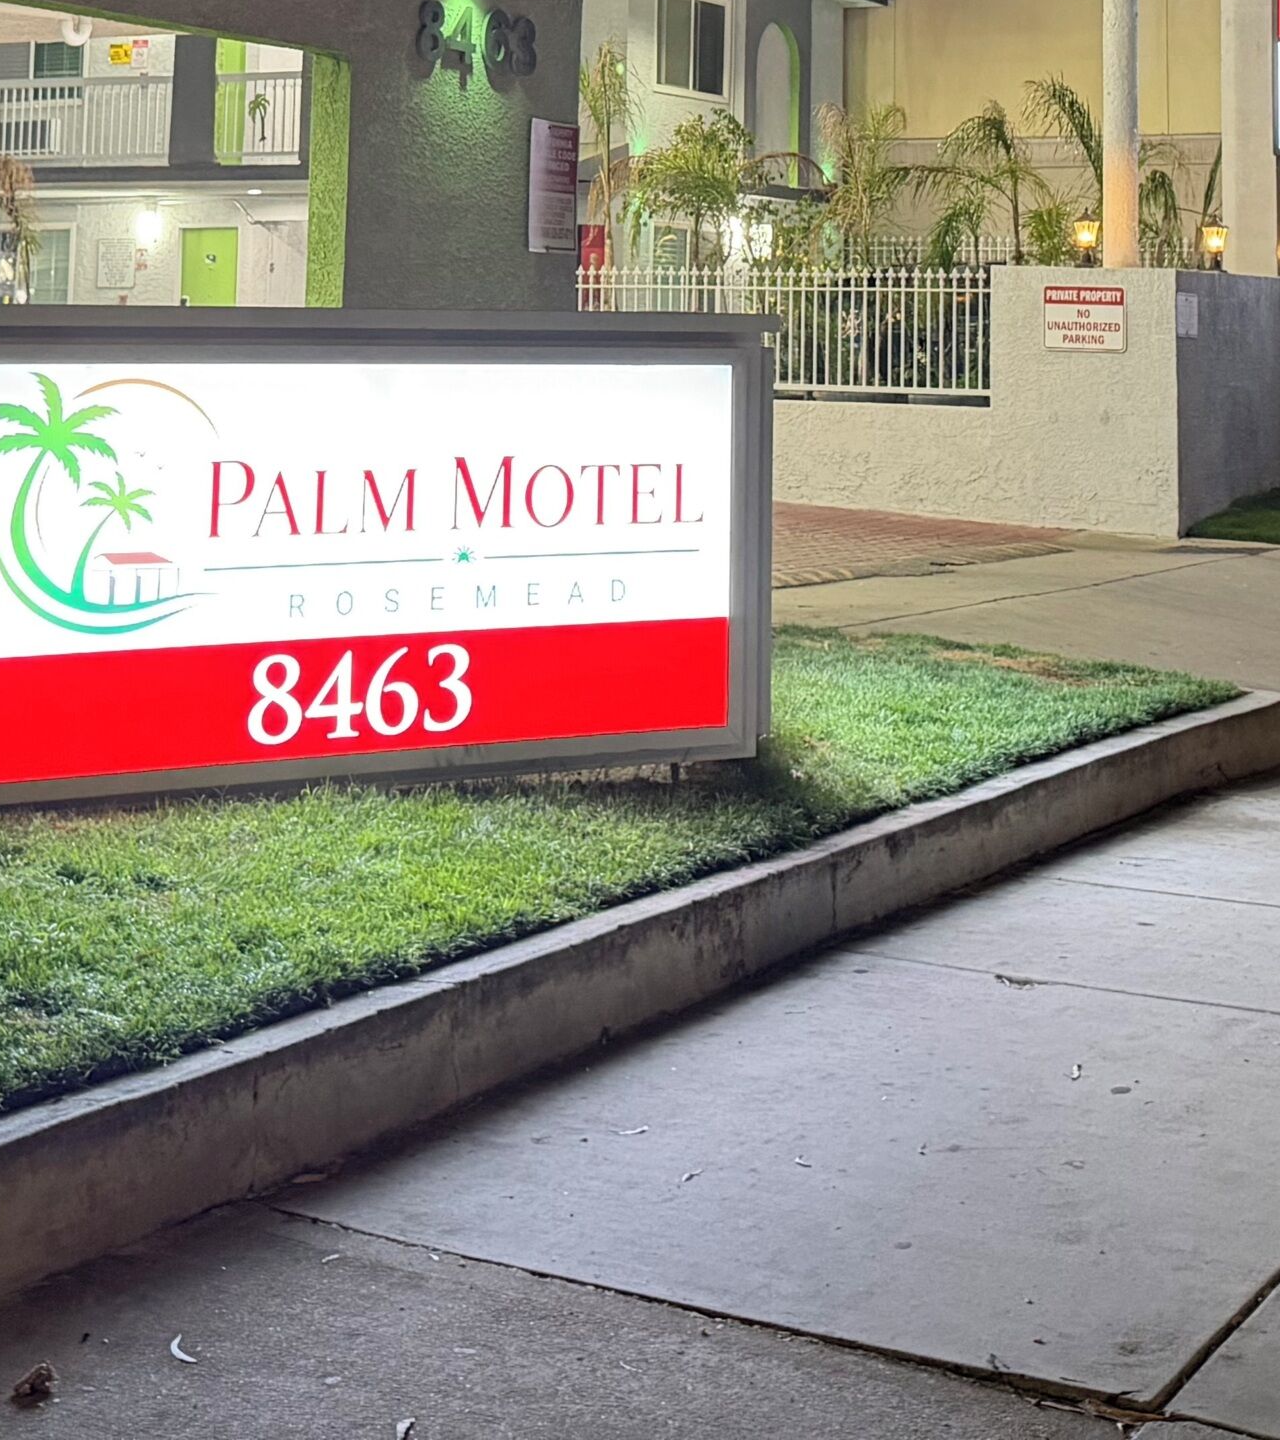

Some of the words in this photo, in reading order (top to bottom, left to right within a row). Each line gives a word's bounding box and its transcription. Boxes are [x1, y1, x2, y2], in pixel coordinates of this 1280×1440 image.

[1046, 289, 1079, 301] PRIVATE
[1080, 290, 1122, 302] PROPERTY
[1077, 308, 1090, 319] NO
[1047, 321, 1121, 333] UNAUTHORIZED
[1062, 334, 1105, 345] PARKING
[208, 460, 417, 538] PALM
[453, 455, 705, 530] MOTEL
[288, 579, 629, 619] ROSEMEAD
[246, 643, 474, 746] 8463
